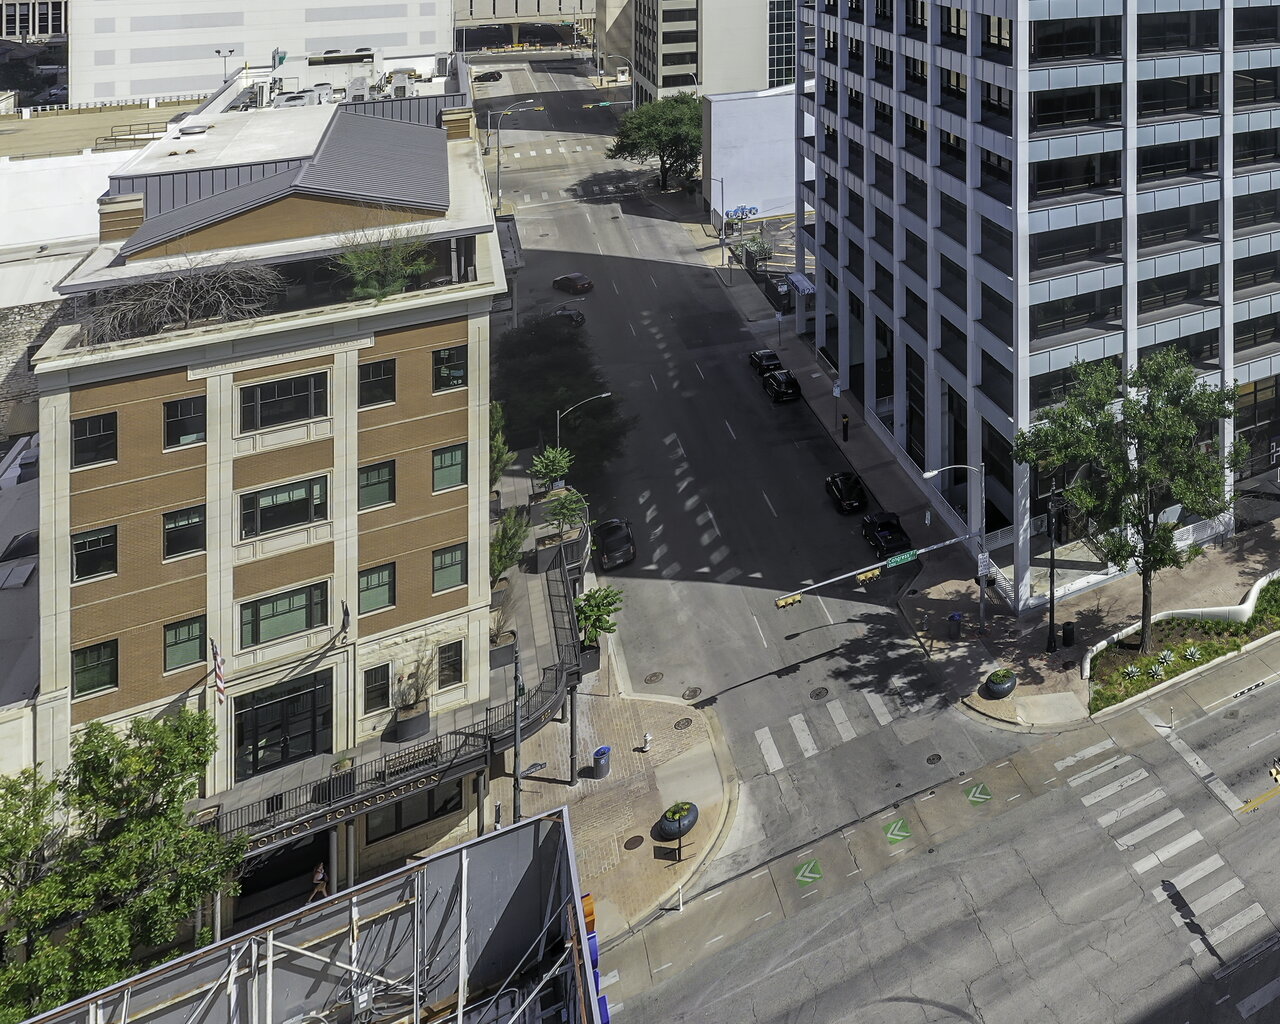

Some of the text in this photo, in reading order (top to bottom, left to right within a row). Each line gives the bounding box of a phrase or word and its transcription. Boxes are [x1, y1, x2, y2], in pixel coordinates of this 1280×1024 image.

[727, 207, 758, 219] PARK
[247, 773, 440, 852] POLICY FOUNDATION
